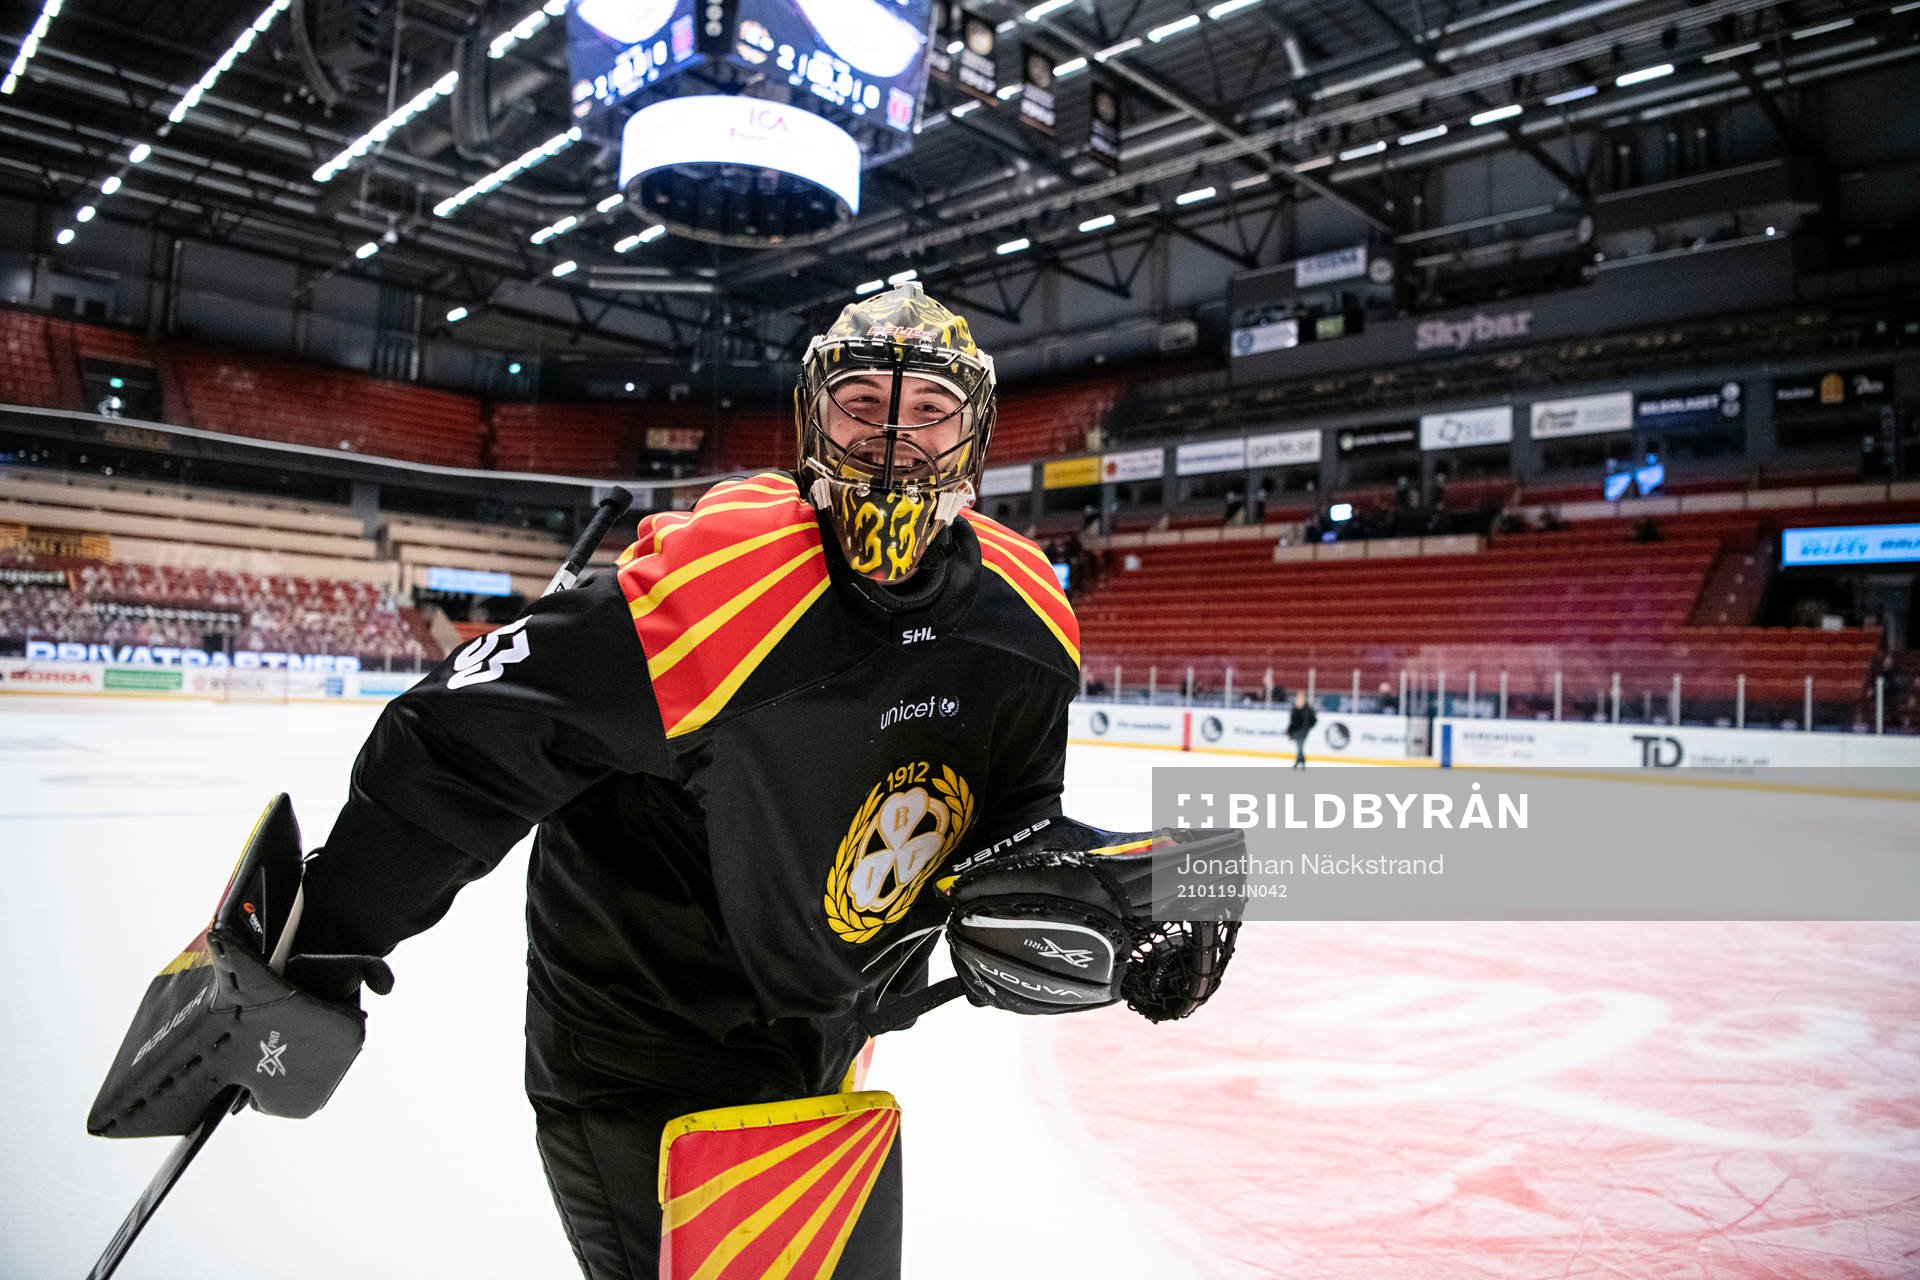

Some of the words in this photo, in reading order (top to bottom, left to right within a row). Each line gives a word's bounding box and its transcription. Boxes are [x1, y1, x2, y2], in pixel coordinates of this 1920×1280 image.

[1415, 311, 1534, 350] Skybar
[902, 626, 936, 645] SHL
[880, 696, 935, 730] unicef
[887, 761, 930, 792] 1912
[974, 958, 1082, 998] VAPOR
